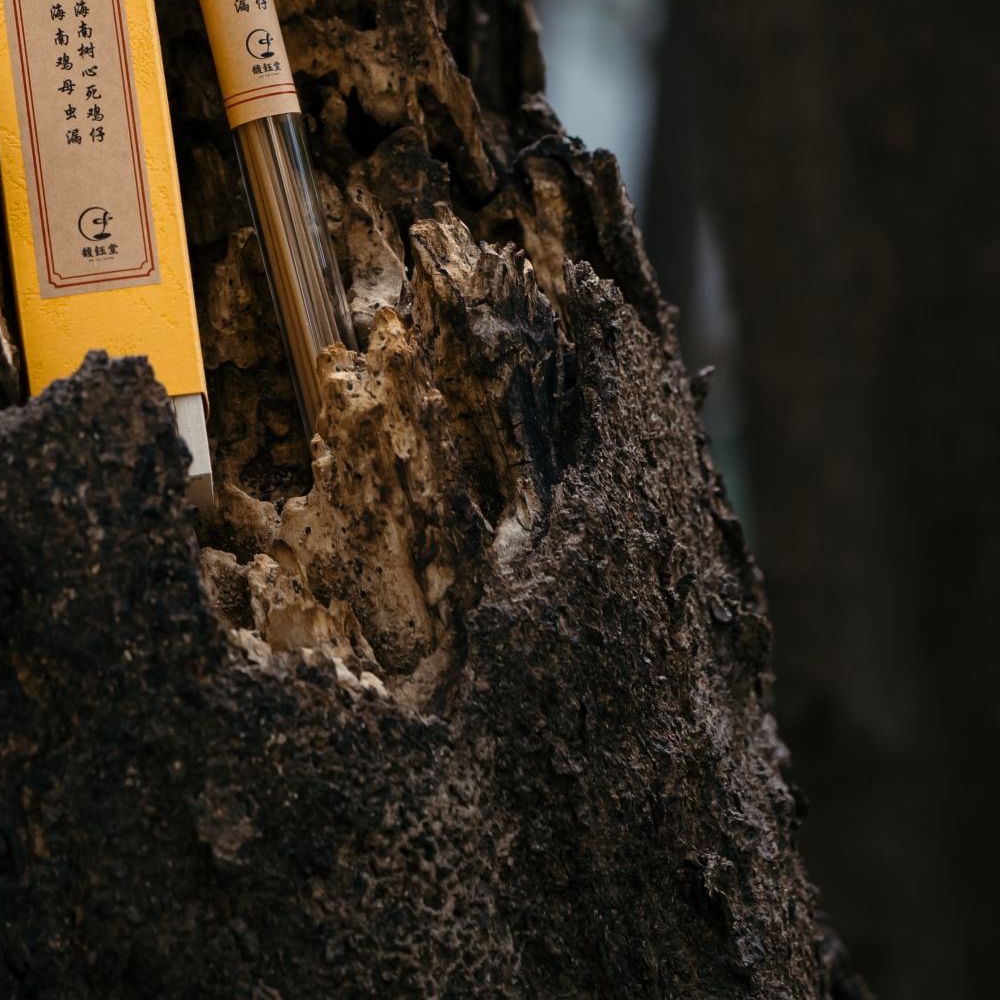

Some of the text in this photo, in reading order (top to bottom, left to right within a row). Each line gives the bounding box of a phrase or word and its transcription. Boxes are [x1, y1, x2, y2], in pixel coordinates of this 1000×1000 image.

[50, 2, 82, 146] 海南鸡母虫漏
[73, 0, 106, 143] 海南树心死鸡仔
